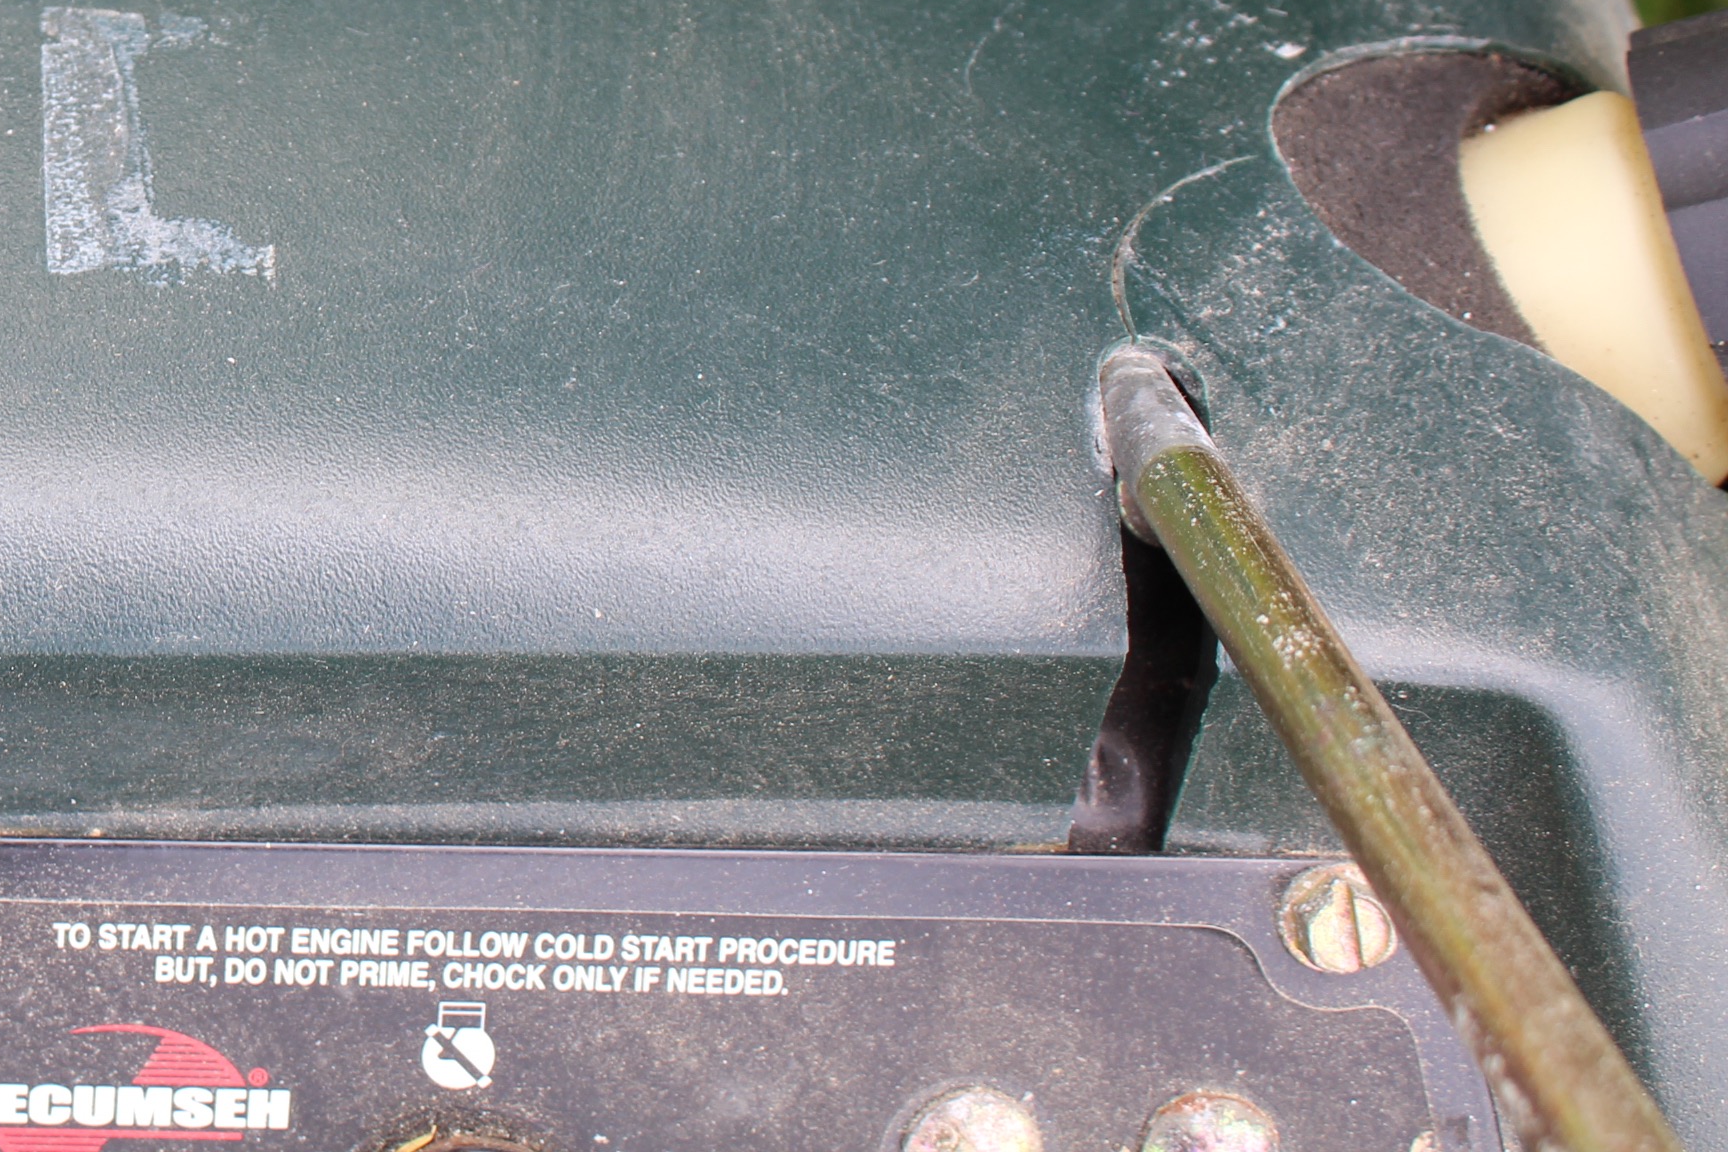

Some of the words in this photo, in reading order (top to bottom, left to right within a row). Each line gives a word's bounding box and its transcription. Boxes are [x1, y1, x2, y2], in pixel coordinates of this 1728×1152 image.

[52, 922, 92, 950] TO
[98, 923, 192, 951] START
[195, 925, 218, 952] A
[224, 926, 286, 953] HOT
[291, 927, 400, 956] ENGINE
[406, 930, 529, 959] FOLLOW
[534, 932, 615, 961] COLD
[620, 935, 713, 963] START
[718, 937, 897, 967] PROCEDURE
[154, 955, 215, 987] BUT,
[224, 957, 267, 985] DO
[273, 958, 335, 987] NOT
[340, 960, 436, 993] PRIME,
[442, 961, 547, 991] CHOCK
[552, 964, 629, 993] ONLY
[633, 966, 661, 993] IF
[666, 967, 789, 996] NEEDED.
